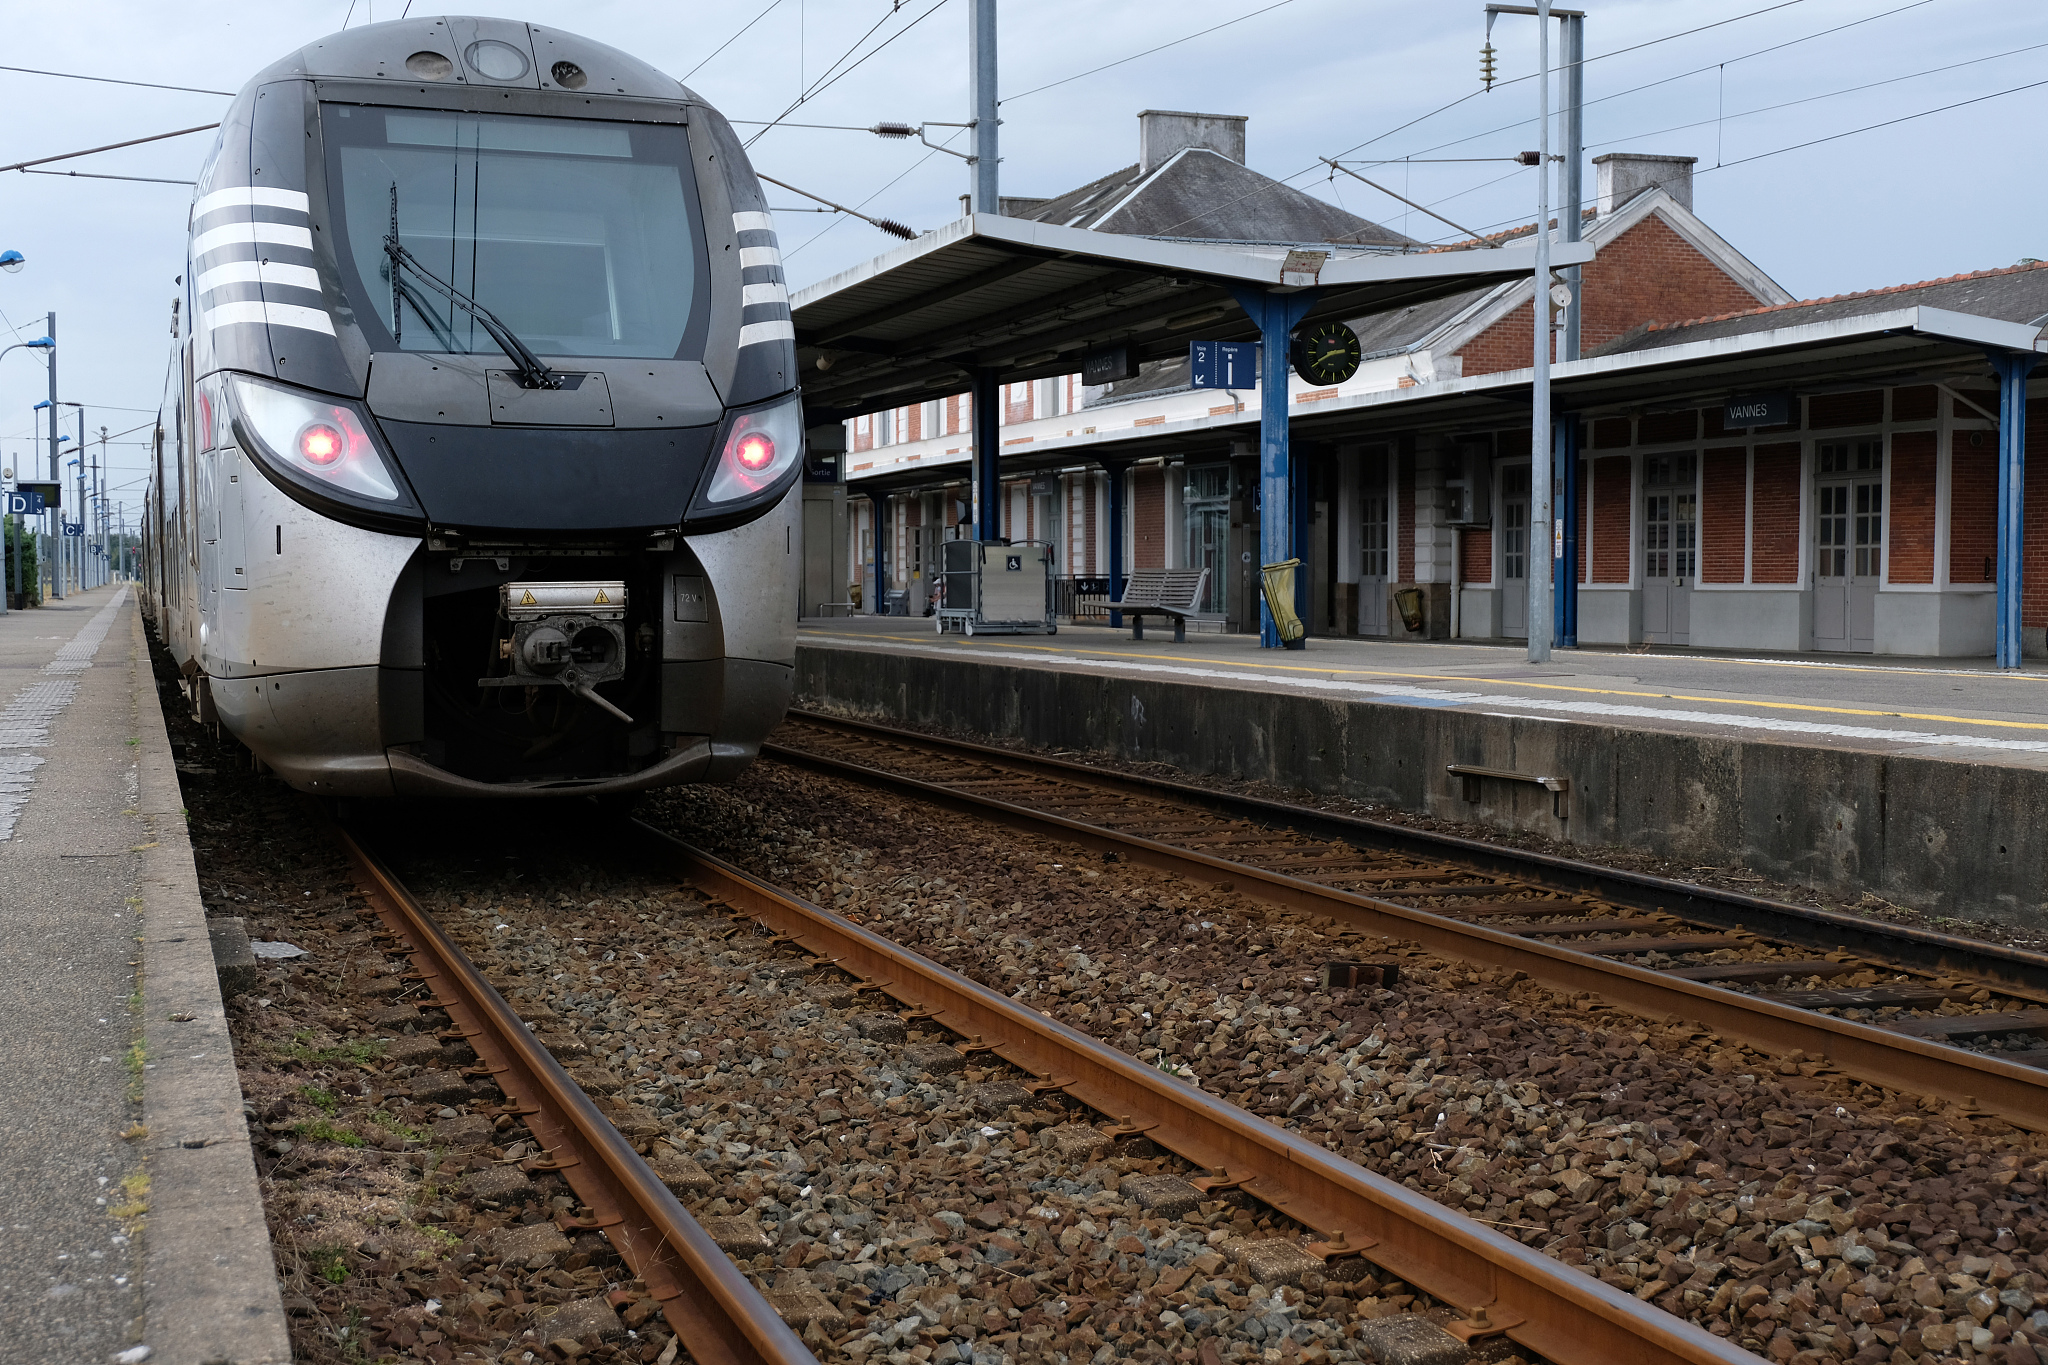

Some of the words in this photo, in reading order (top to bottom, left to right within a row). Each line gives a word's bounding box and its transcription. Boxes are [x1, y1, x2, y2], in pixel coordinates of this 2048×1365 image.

[1198, 352, 1205, 362] 2
[1085, 355, 1113, 375] VANNES
[1729, 403, 1768, 419] VANNES
[811, 468, 831, 476] Sortie
[12, 497, 26, 512] D
[66, 526, 75, 535] C
[680, 593, 690, 602] 72
[691, 594, 697, 602] V
